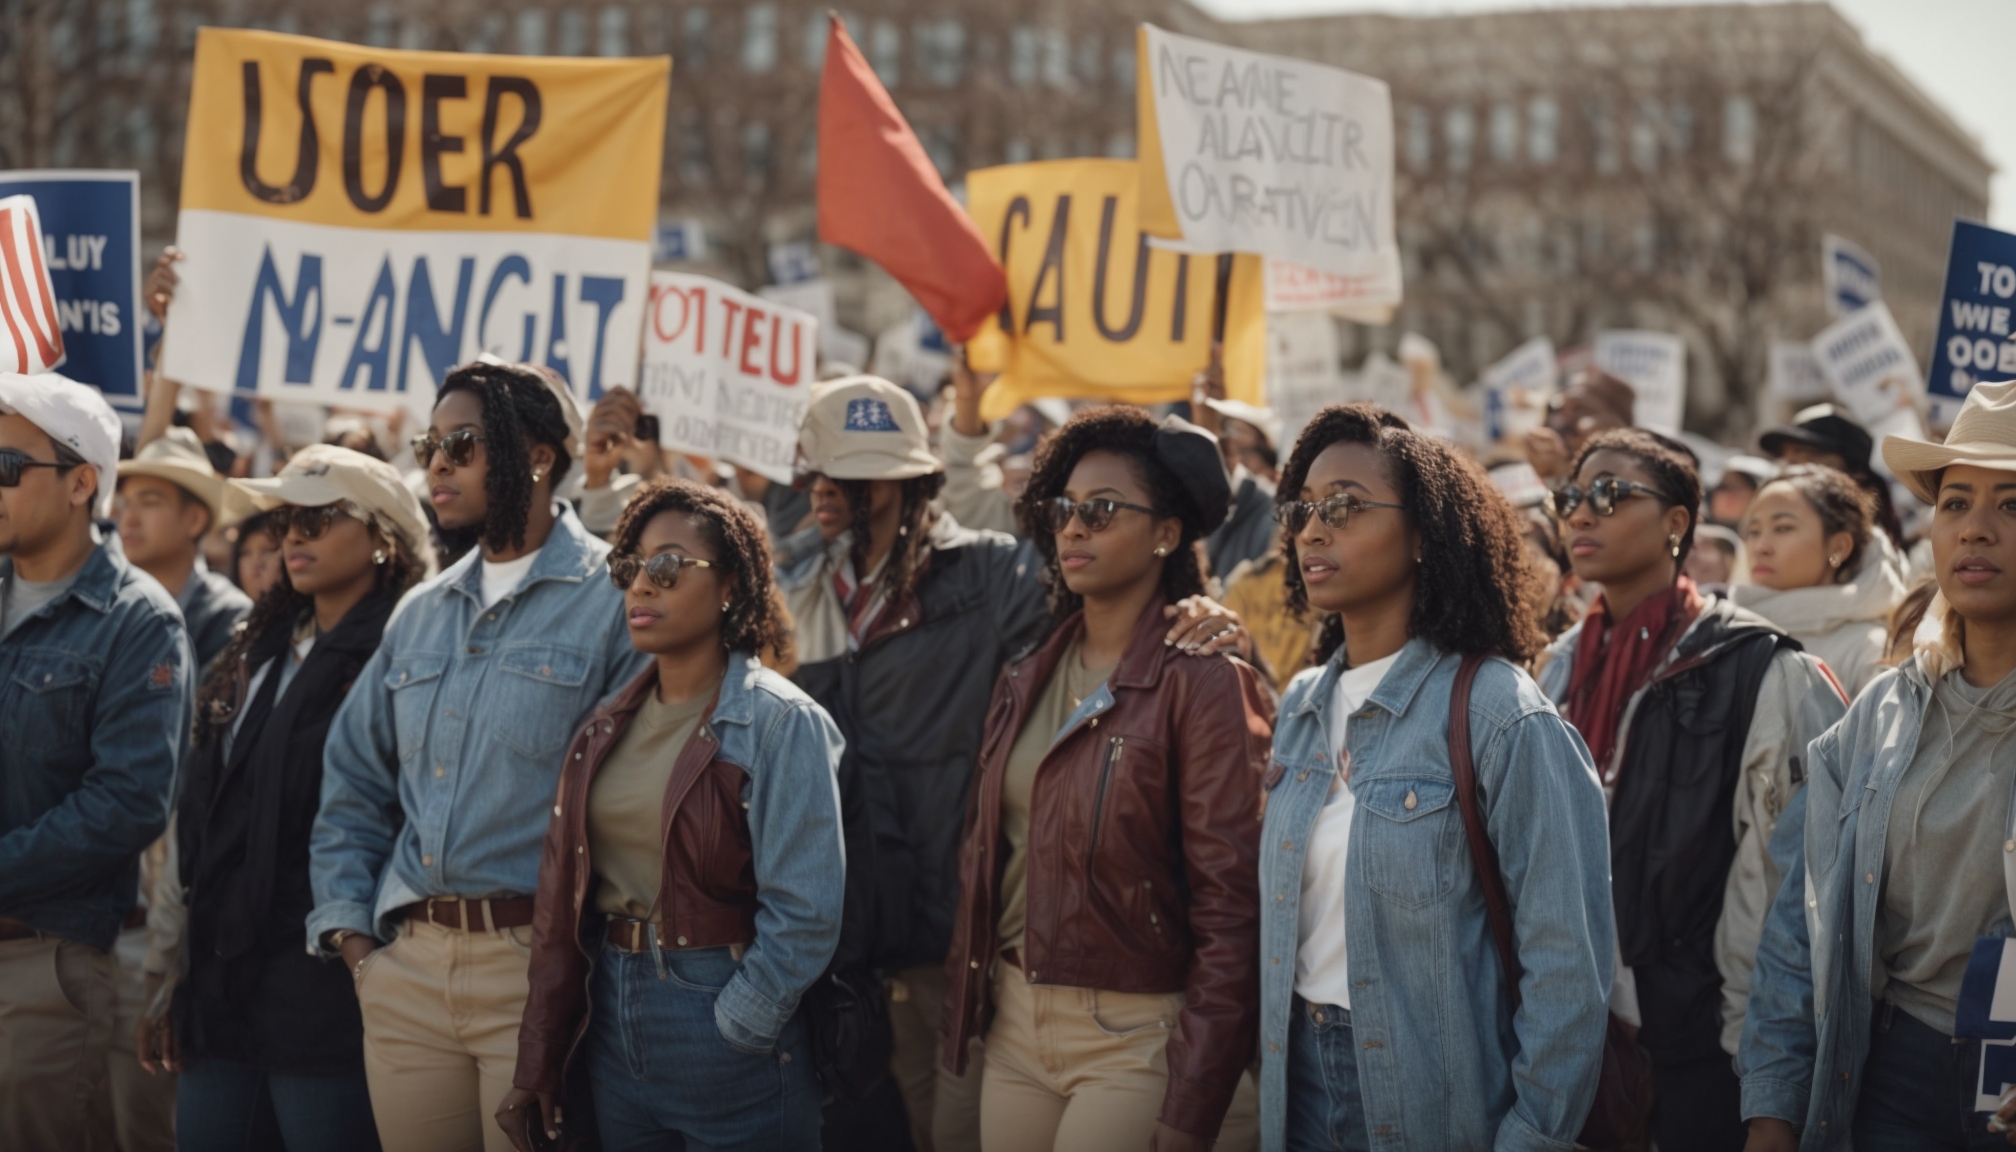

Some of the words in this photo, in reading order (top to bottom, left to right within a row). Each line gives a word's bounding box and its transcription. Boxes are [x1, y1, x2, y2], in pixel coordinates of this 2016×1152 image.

[1976, 261, 2016, 299] TO
[1951, 299, 2012, 337] WE
[719, 297, 803, 388] TEU
